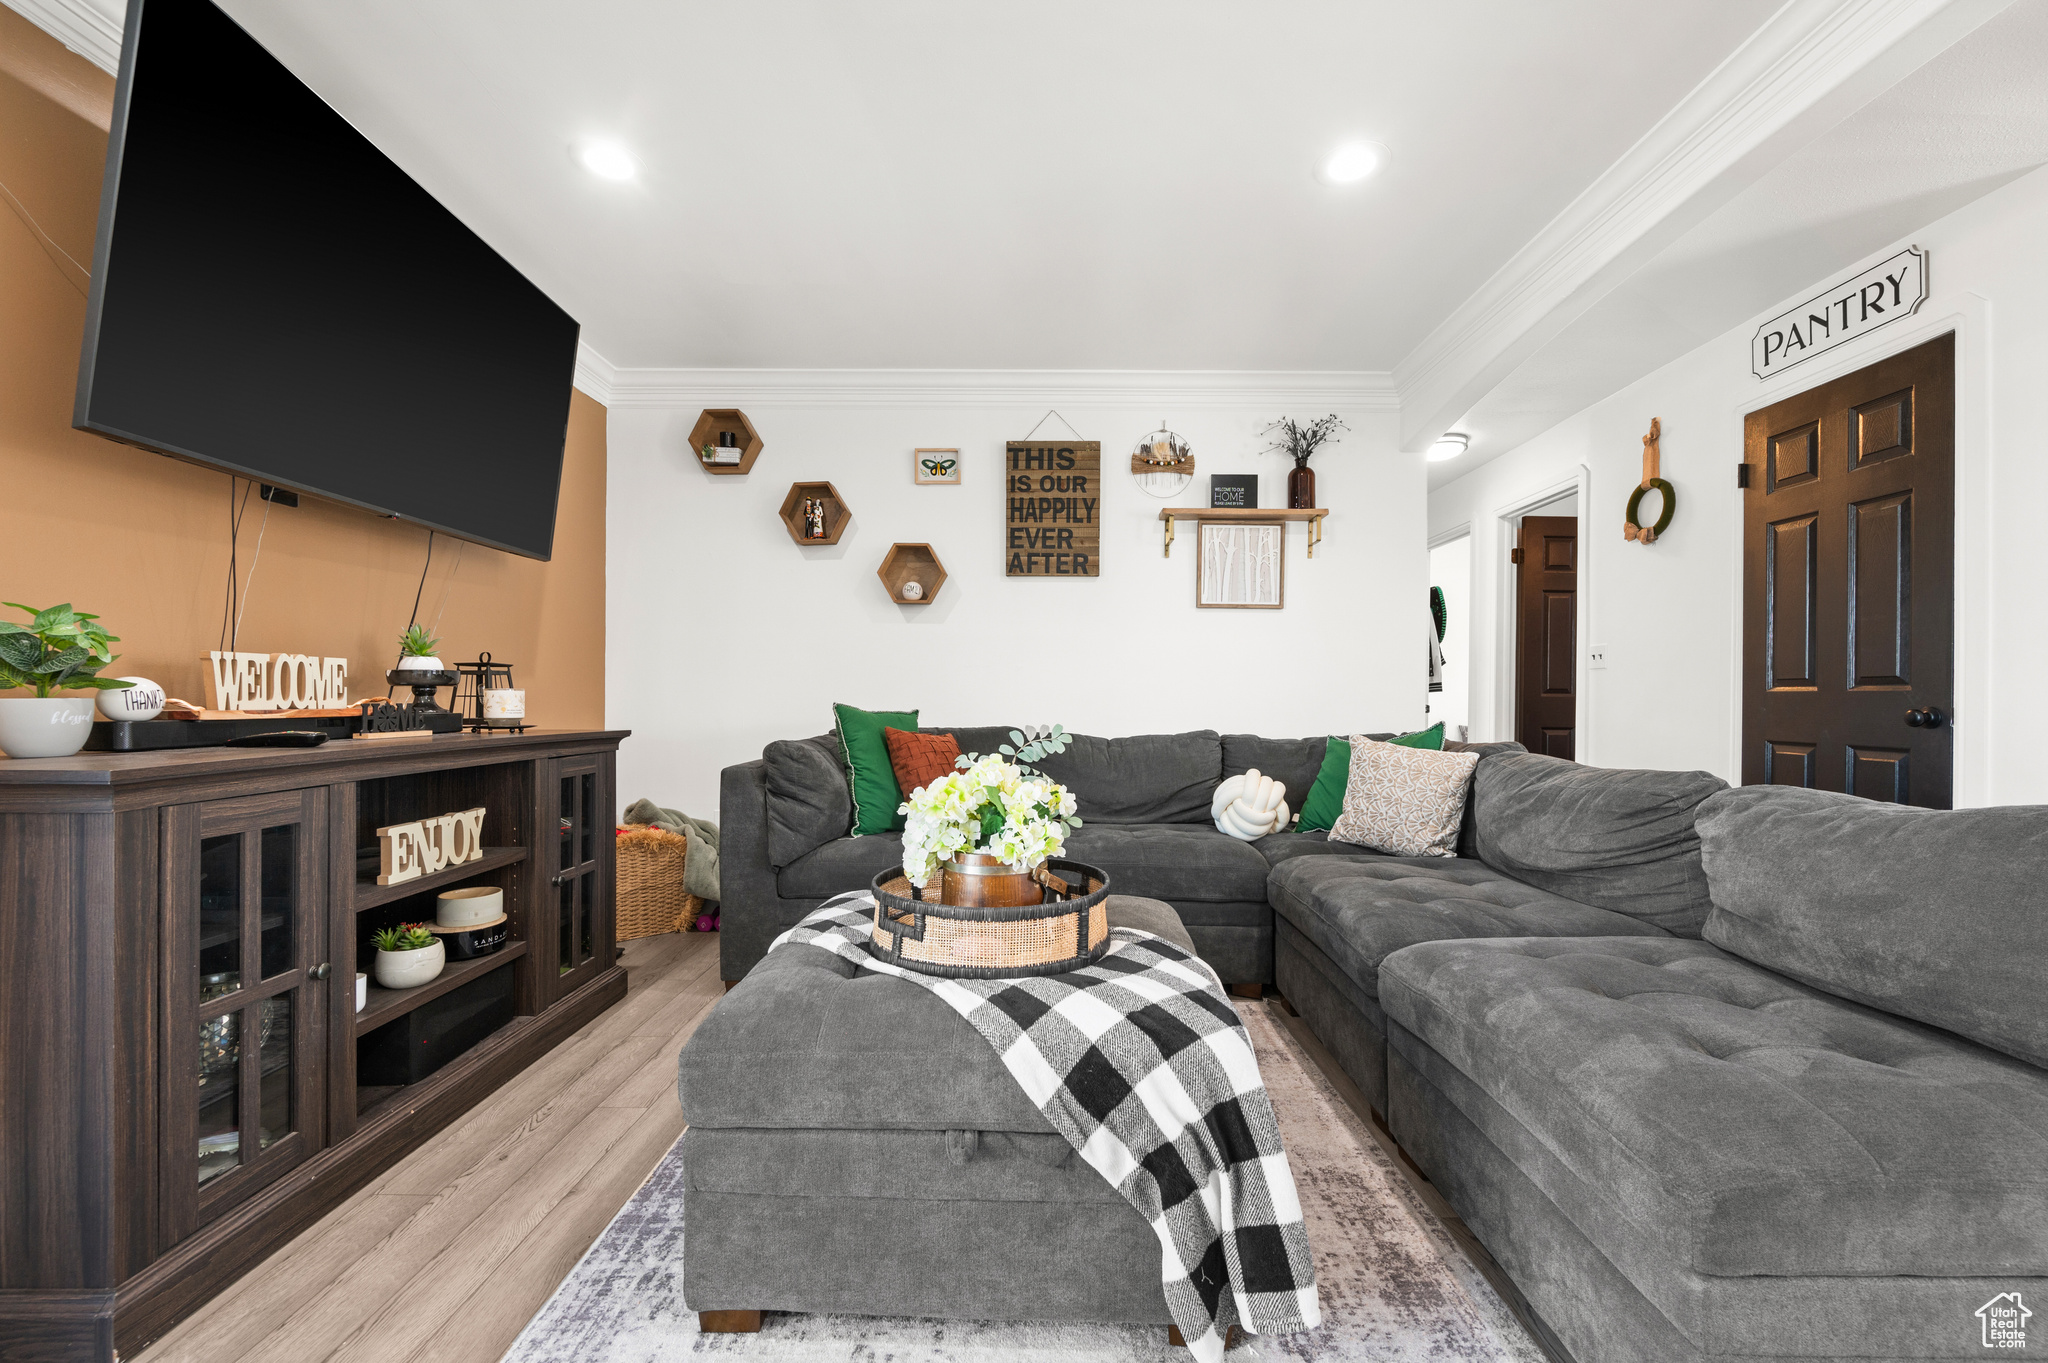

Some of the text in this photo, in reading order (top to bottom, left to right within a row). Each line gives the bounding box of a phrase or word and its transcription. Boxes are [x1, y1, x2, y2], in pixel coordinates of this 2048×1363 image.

[1763, 266, 1908, 367] PANTRY
[1008, 447, 1076, 471] THIS
[1010, 475, 1088, 493] IS OUR
[1214, 491, 1244, 502] HOME
[1010, 497, 1097, 523] HAPPILY
[1009, 527, 1074, 549] EVER
[1008, 552, 1089, 575] AFTER
[209, 650, 348, 711] WELCOME
[385, 807, 487, 886] ENJOY
[474, 934, 499, 947] SAND
